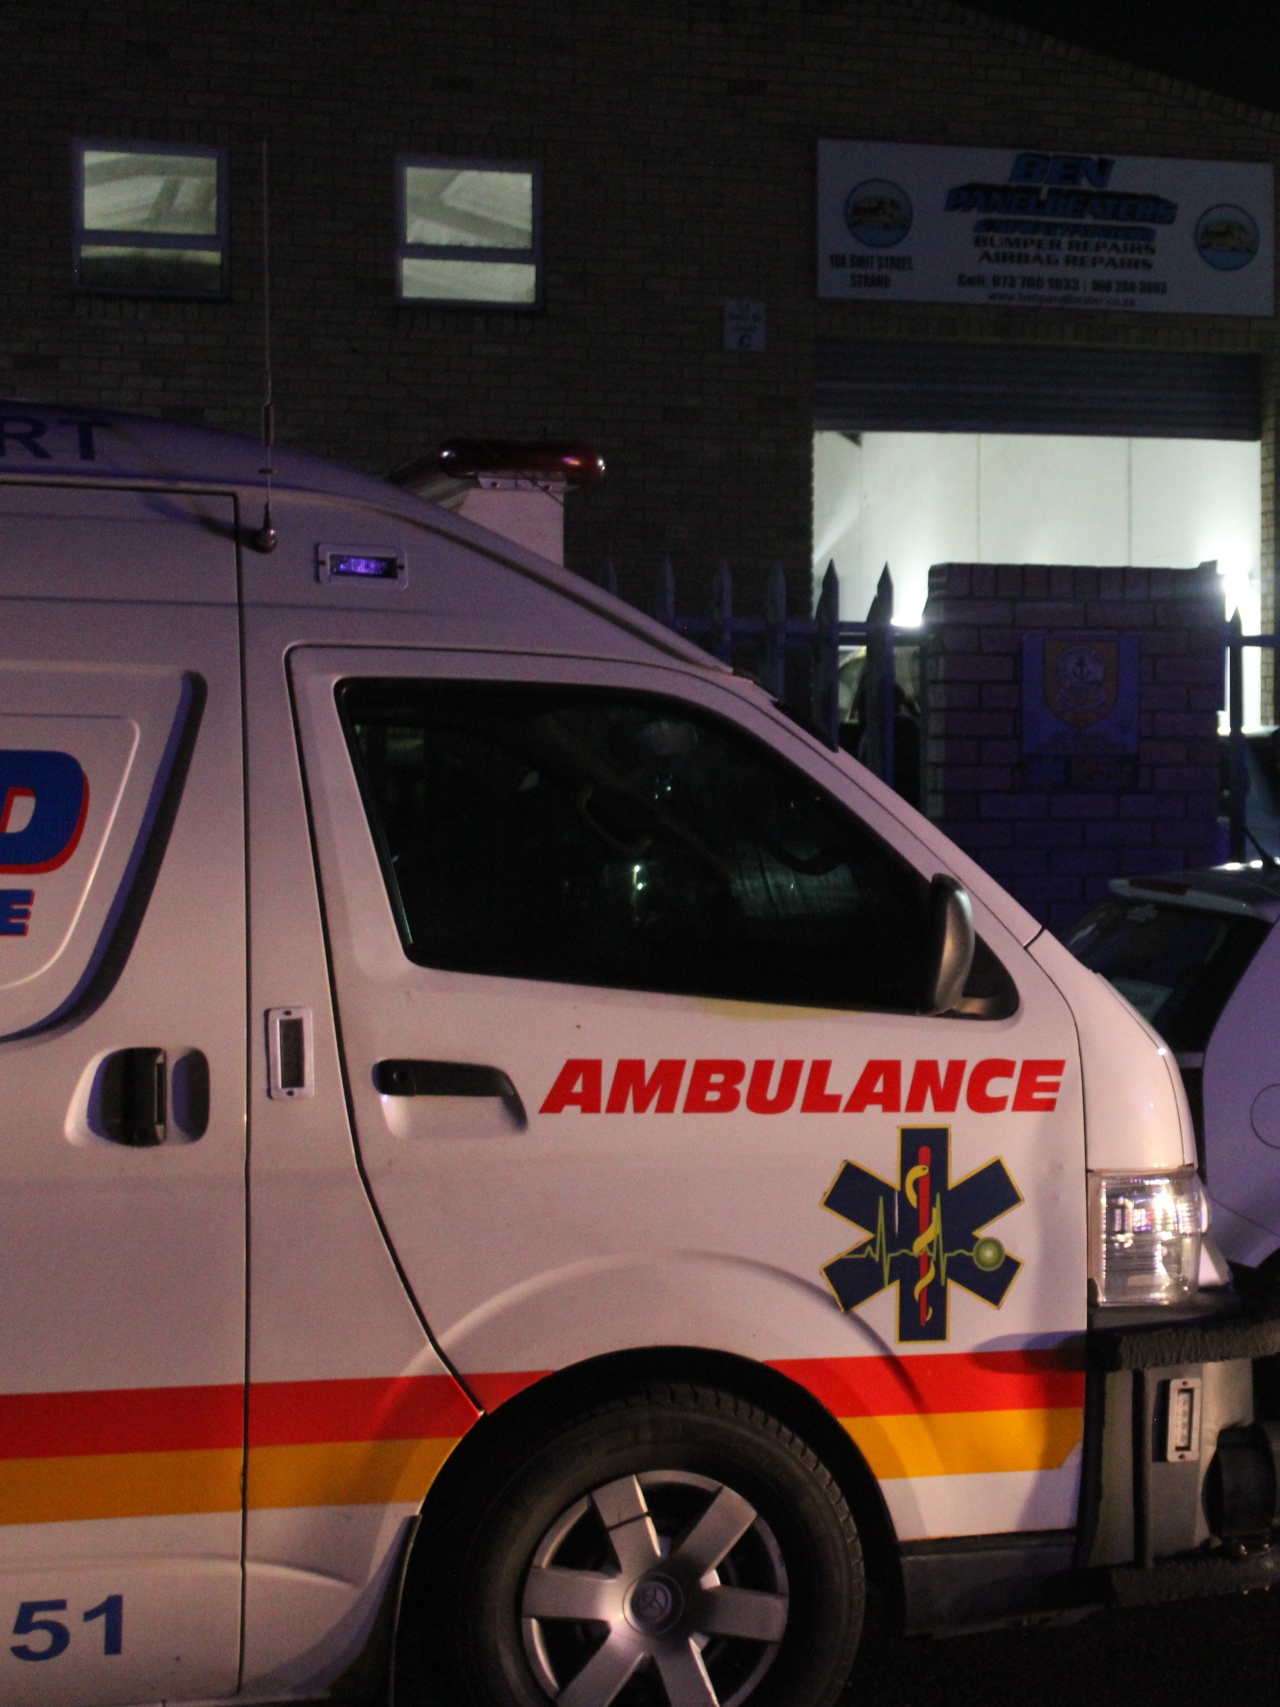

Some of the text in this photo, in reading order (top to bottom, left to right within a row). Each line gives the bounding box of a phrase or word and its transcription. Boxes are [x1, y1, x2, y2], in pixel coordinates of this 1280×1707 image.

[1009, 152, 1116, 188] BEN
[944, 183, 1178, 223] PANELBEATERS
[974, 236, 1156, 256] BUMPER REPAIRS
[979, 251, 1153, 270] AIRBAG REPAIRS
[850, 273, 891, 288] STRAND
[541, 1059, 1065, 1114] AMBULANCE
[10, 1595, 123, 1661] 51
